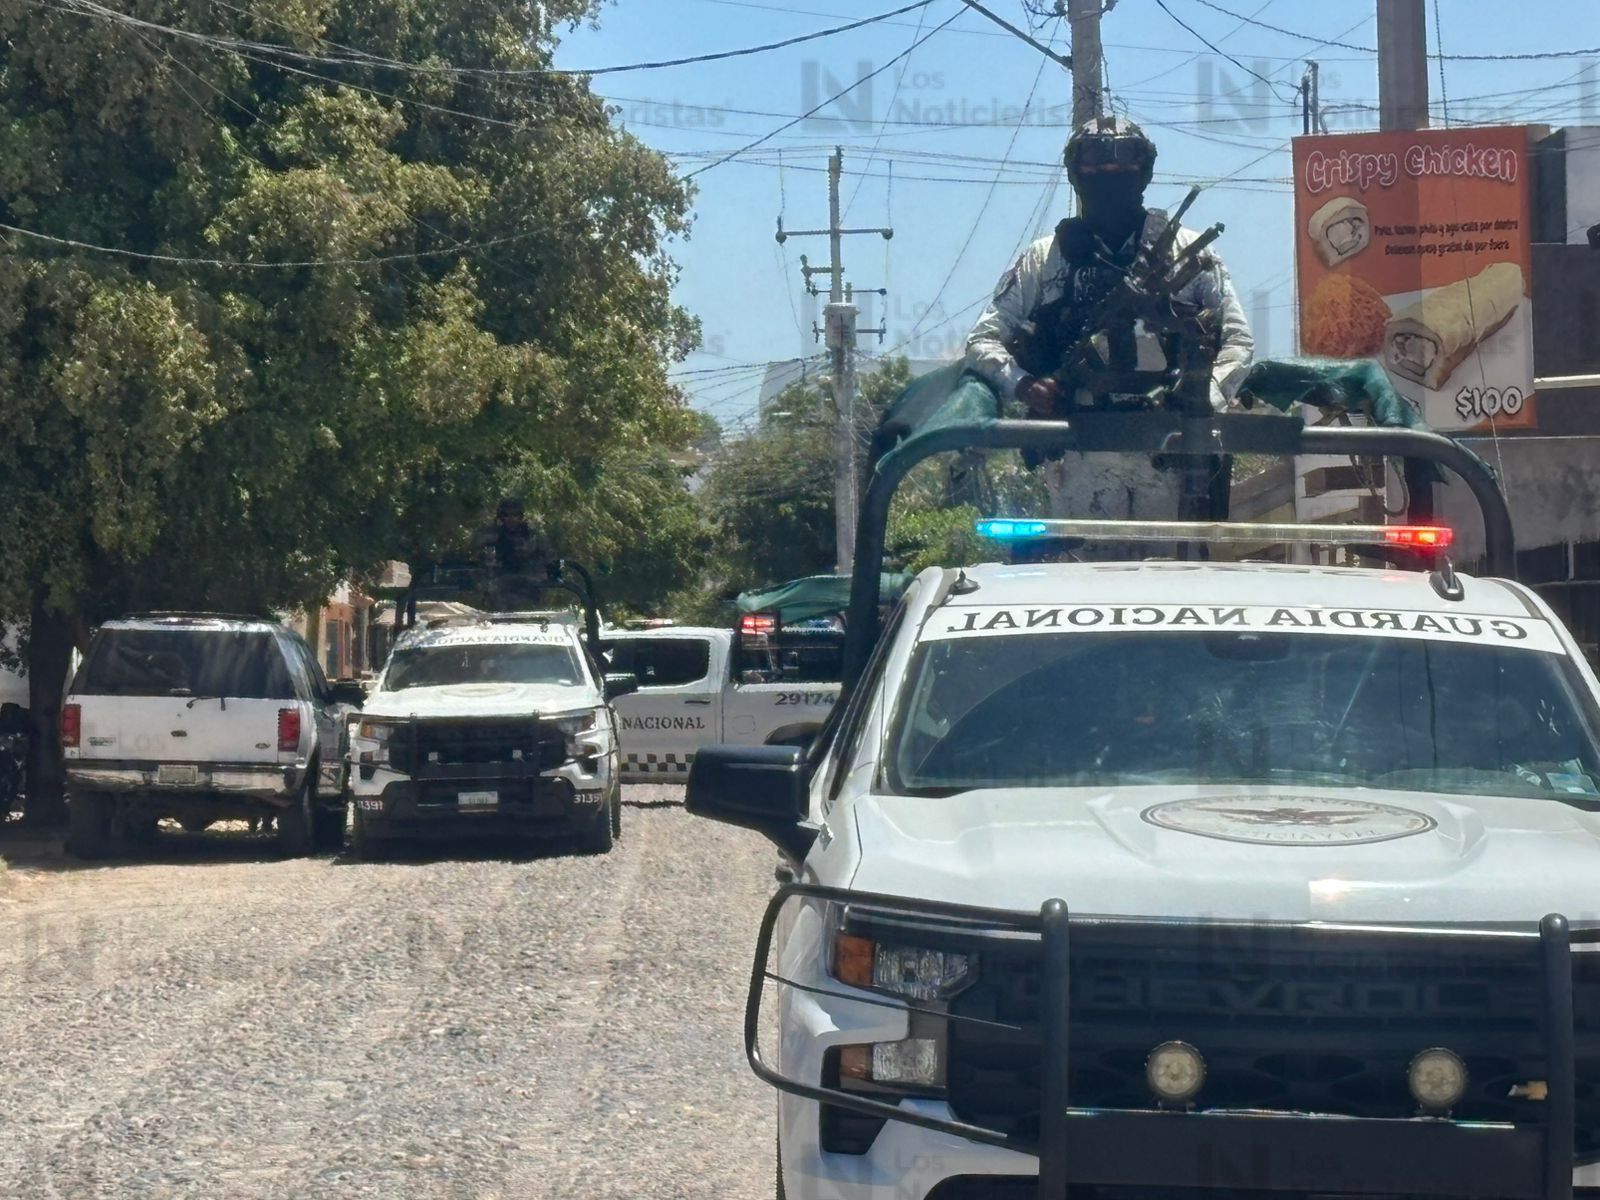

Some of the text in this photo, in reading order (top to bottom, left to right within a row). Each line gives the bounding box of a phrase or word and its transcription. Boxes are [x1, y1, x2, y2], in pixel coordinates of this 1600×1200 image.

[1305, 143, 1518, 193] Crispy Chicken
[1455, 385, 1523, 421] $100
[621, 716, 705, 730] NACIONAL
